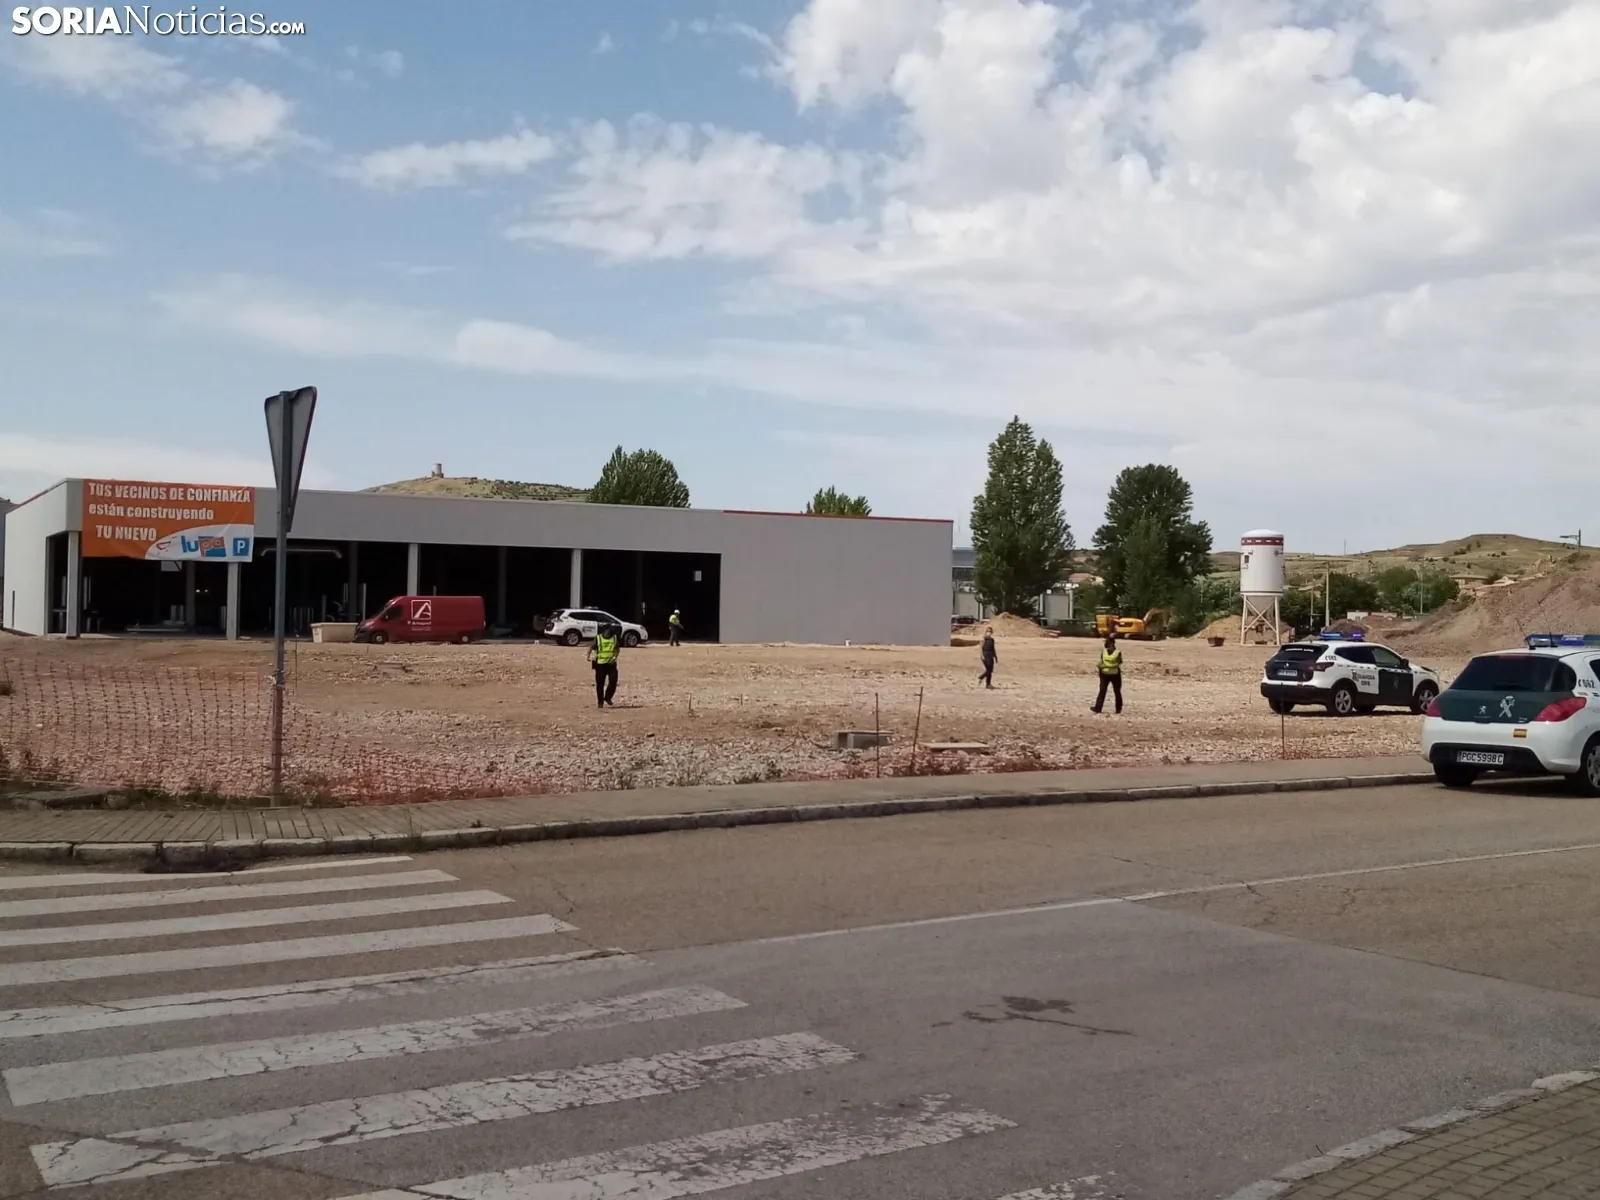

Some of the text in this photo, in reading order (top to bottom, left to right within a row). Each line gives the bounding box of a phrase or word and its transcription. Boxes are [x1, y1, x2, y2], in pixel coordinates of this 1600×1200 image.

[88, 482, 251, 503] TUS VECINOS DE CONFIANZA
[88, 503, 214, 521] están construyendo
[96, 524, 157, 541] TU NUEVO
[180, 535, 227, 558] lupa
[1462, 752, 1477, 762] PGC
